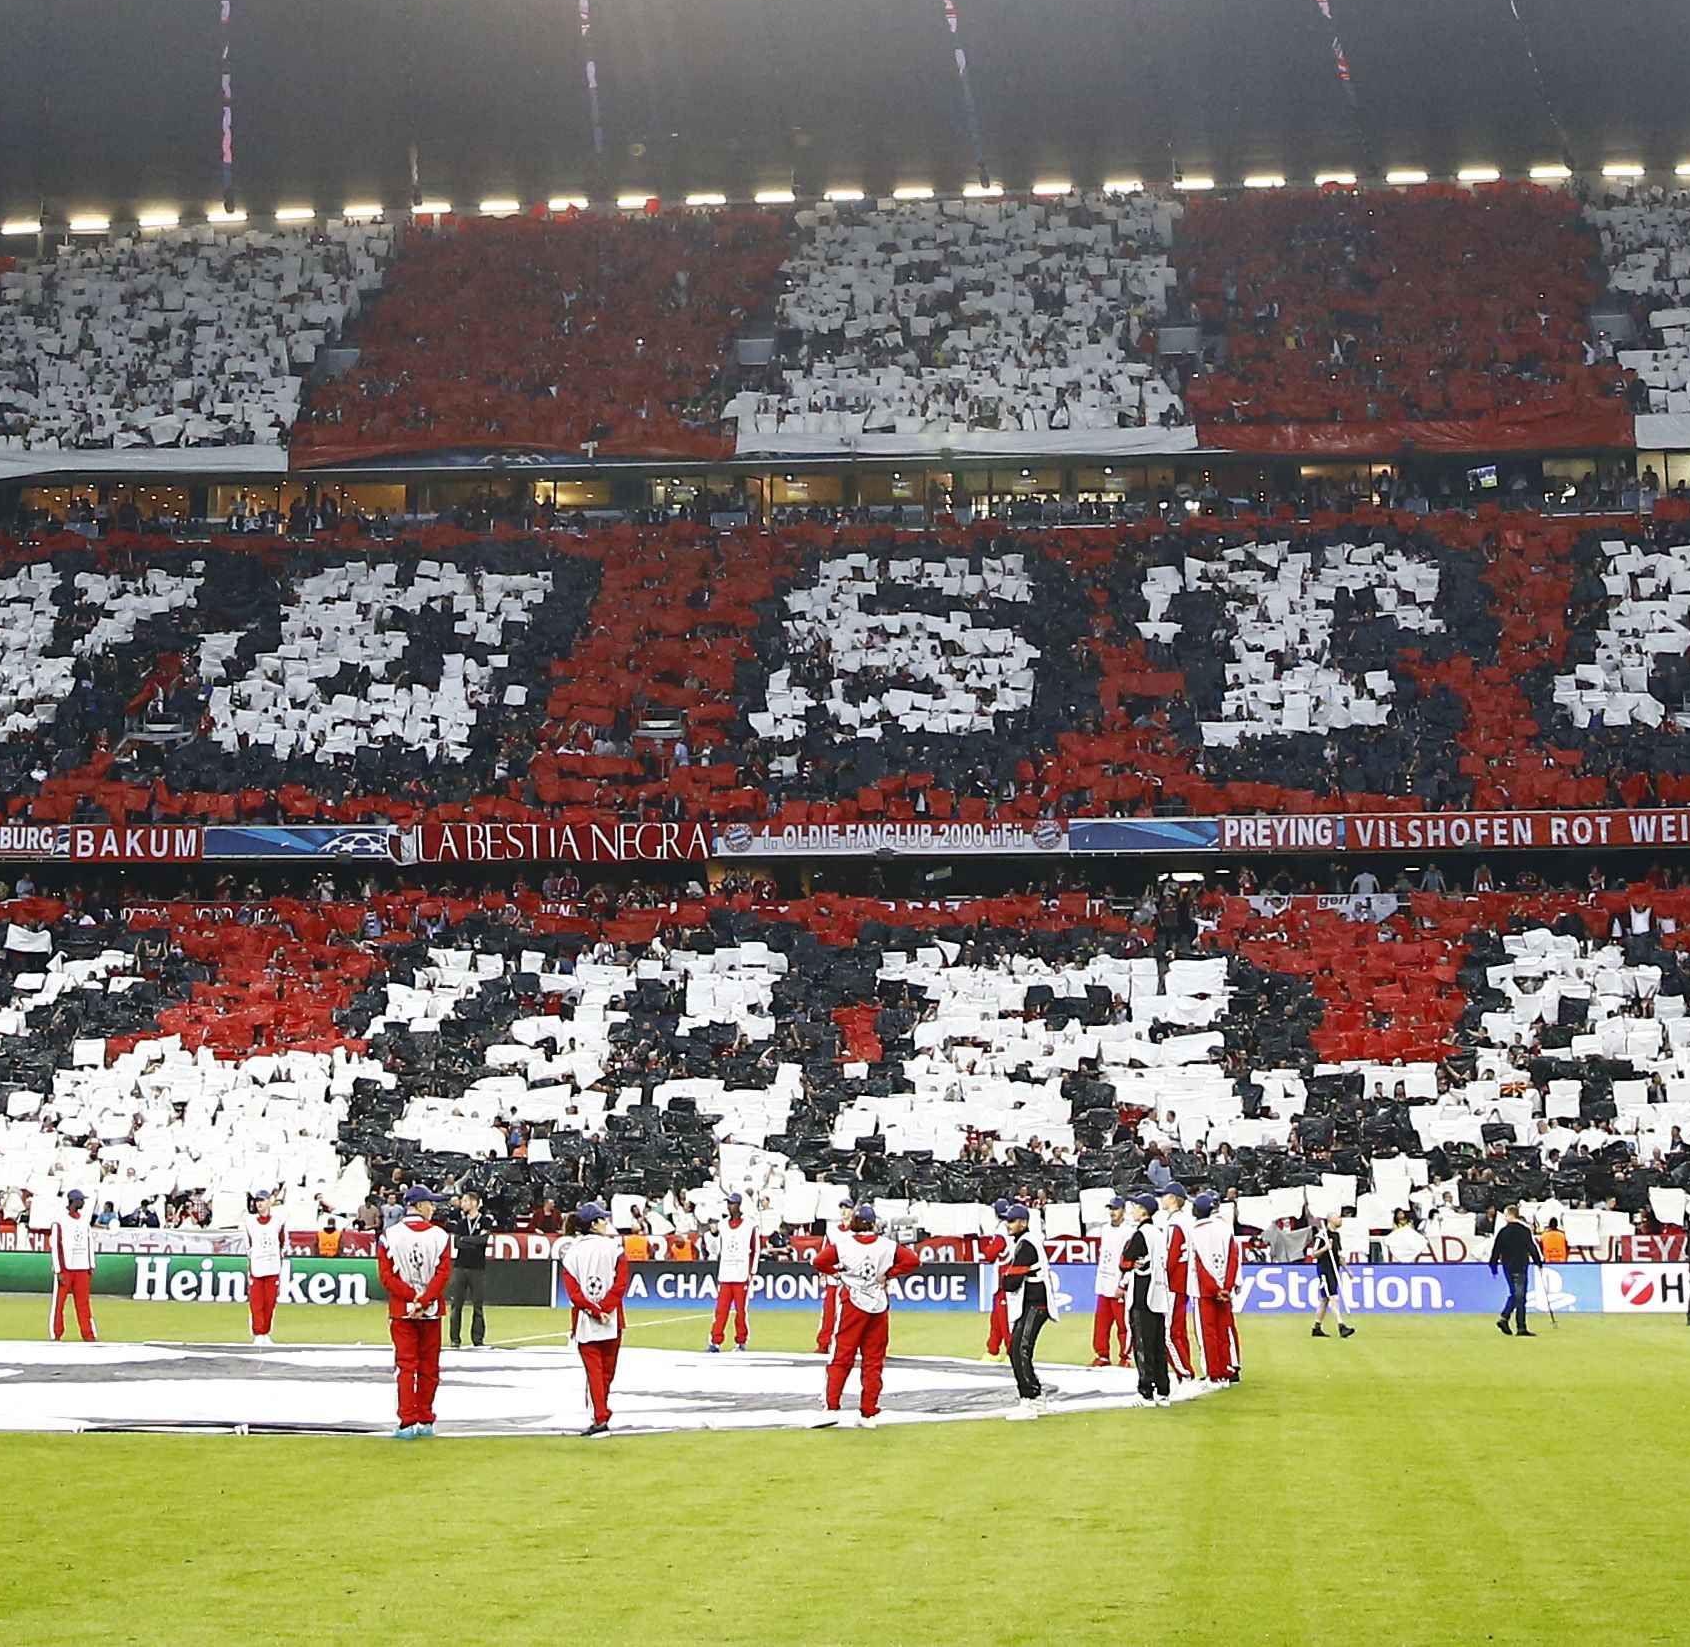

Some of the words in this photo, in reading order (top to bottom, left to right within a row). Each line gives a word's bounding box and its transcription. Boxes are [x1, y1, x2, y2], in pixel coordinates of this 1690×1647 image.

[77, 829, 197, 859] BAKUM
[415, 824, 460, 862] LA
[466, 823, 582, 861] BESTIA
[591, 823, 709, 862] NEGRA
[783, 824, 840, 849] OLDIE
[845, 823, 932, 849] FANCLUB
[938, 823, 983, 848] 2000
[1224, 818, 1333, 847] PREYING
[1354, 817, 1533, 848] VILSHOFEN
[1550, 816, 1611, 846] ROT
[133, 1256, 370, 1305] Heinken
[656, 1273, 826, 1301] CHAPION
